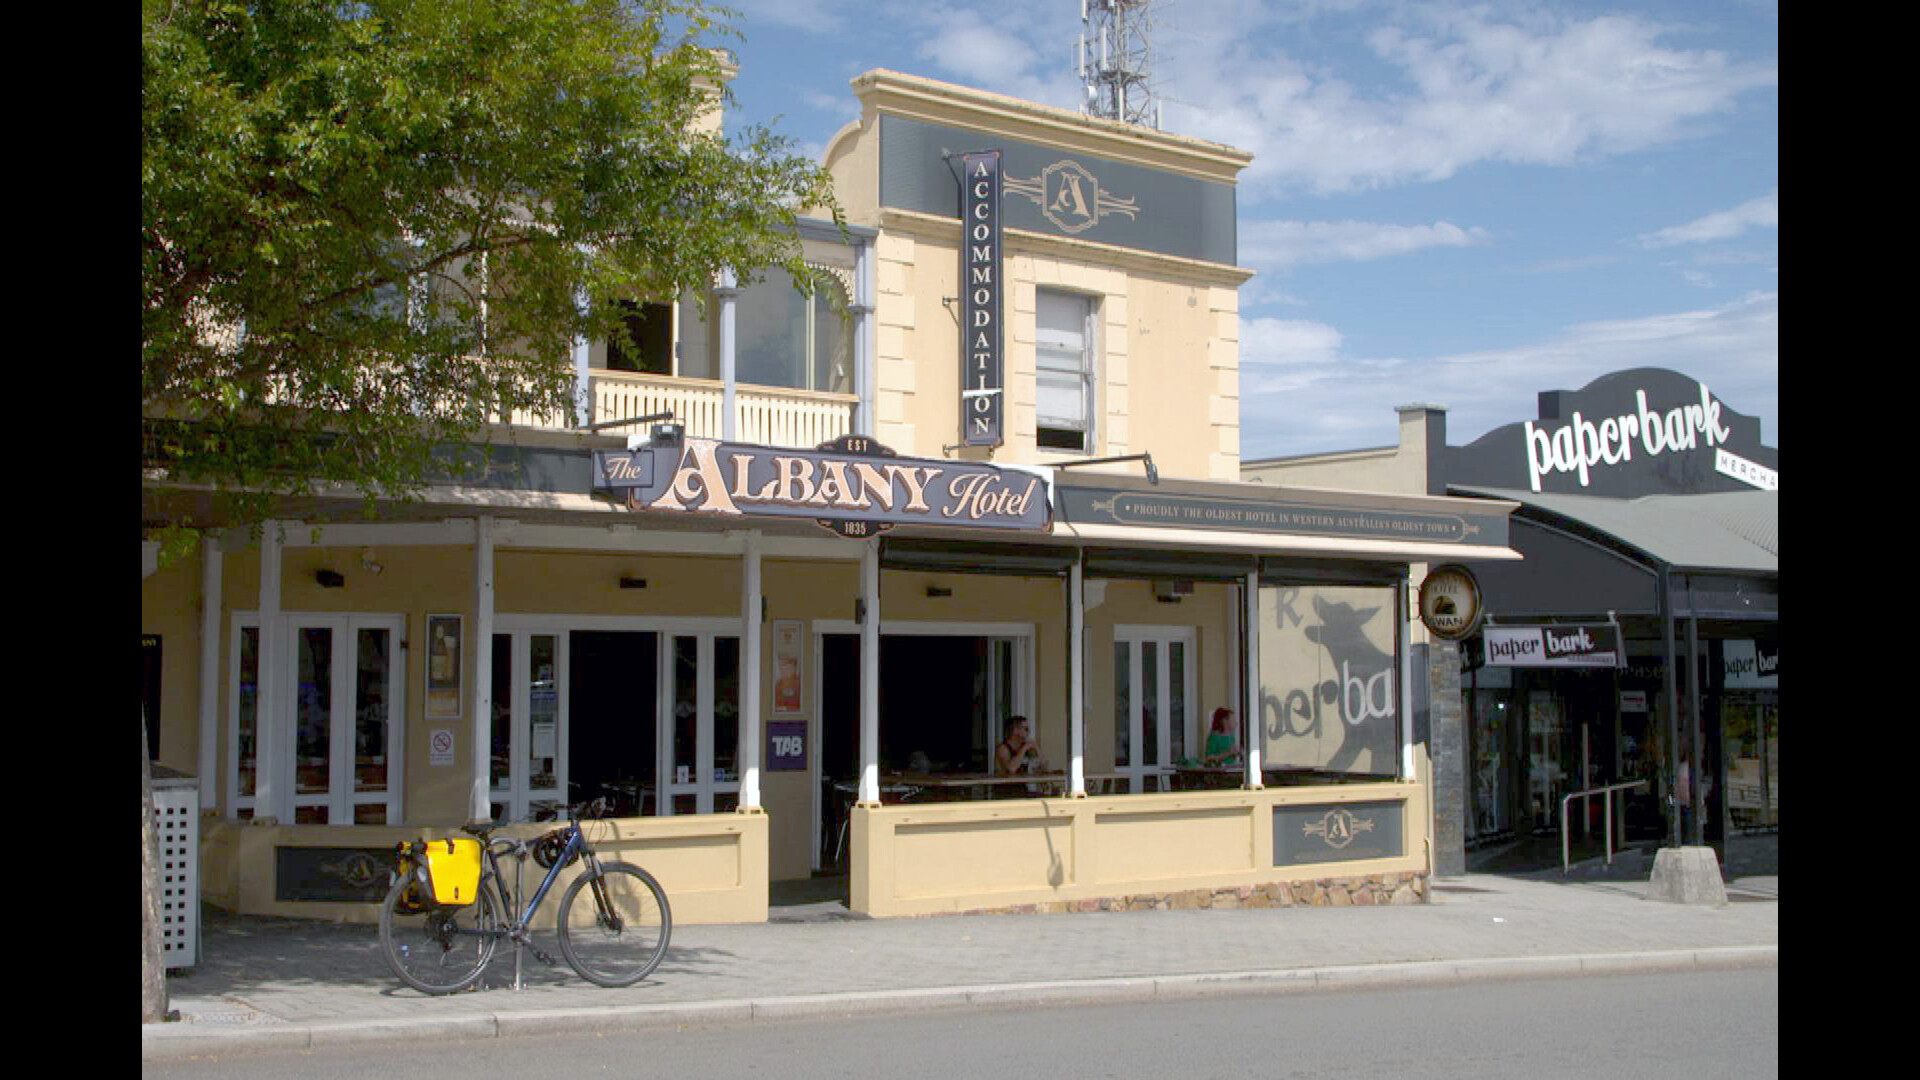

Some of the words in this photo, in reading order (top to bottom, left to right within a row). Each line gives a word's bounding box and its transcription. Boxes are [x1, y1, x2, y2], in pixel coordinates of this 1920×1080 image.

[972, 161, 991, 434] ACCOMMODATION
[847, 439, 868, 452] EST
[1524, 383, 1730, 494] paperbark
[602, 456, 642, 481] The
[651, 437, 943, 515] ALBANY
[942, 472, 1037, 519] Hotel
[844, 521, 867, 536] 1835
[1133, 503, 1180, 518] PROUDLY
[1184, 506, 1201, 519] THE
[1205, 508, 1242, 522] OLDEST
[1245, 511, 1277, 524] HOTEL
[1279, 512, 1290, 524] IN
[1292, 513, 1335, 527] WESTERN
[1391, 520, 1425, 532] OLDEST
[1427, 522, 1450, 534] TOWN
[1489, 637, 1540, 662] paper
[1546, 627, 1596, 654] bark
[771, 735, 804, 757] TAB
